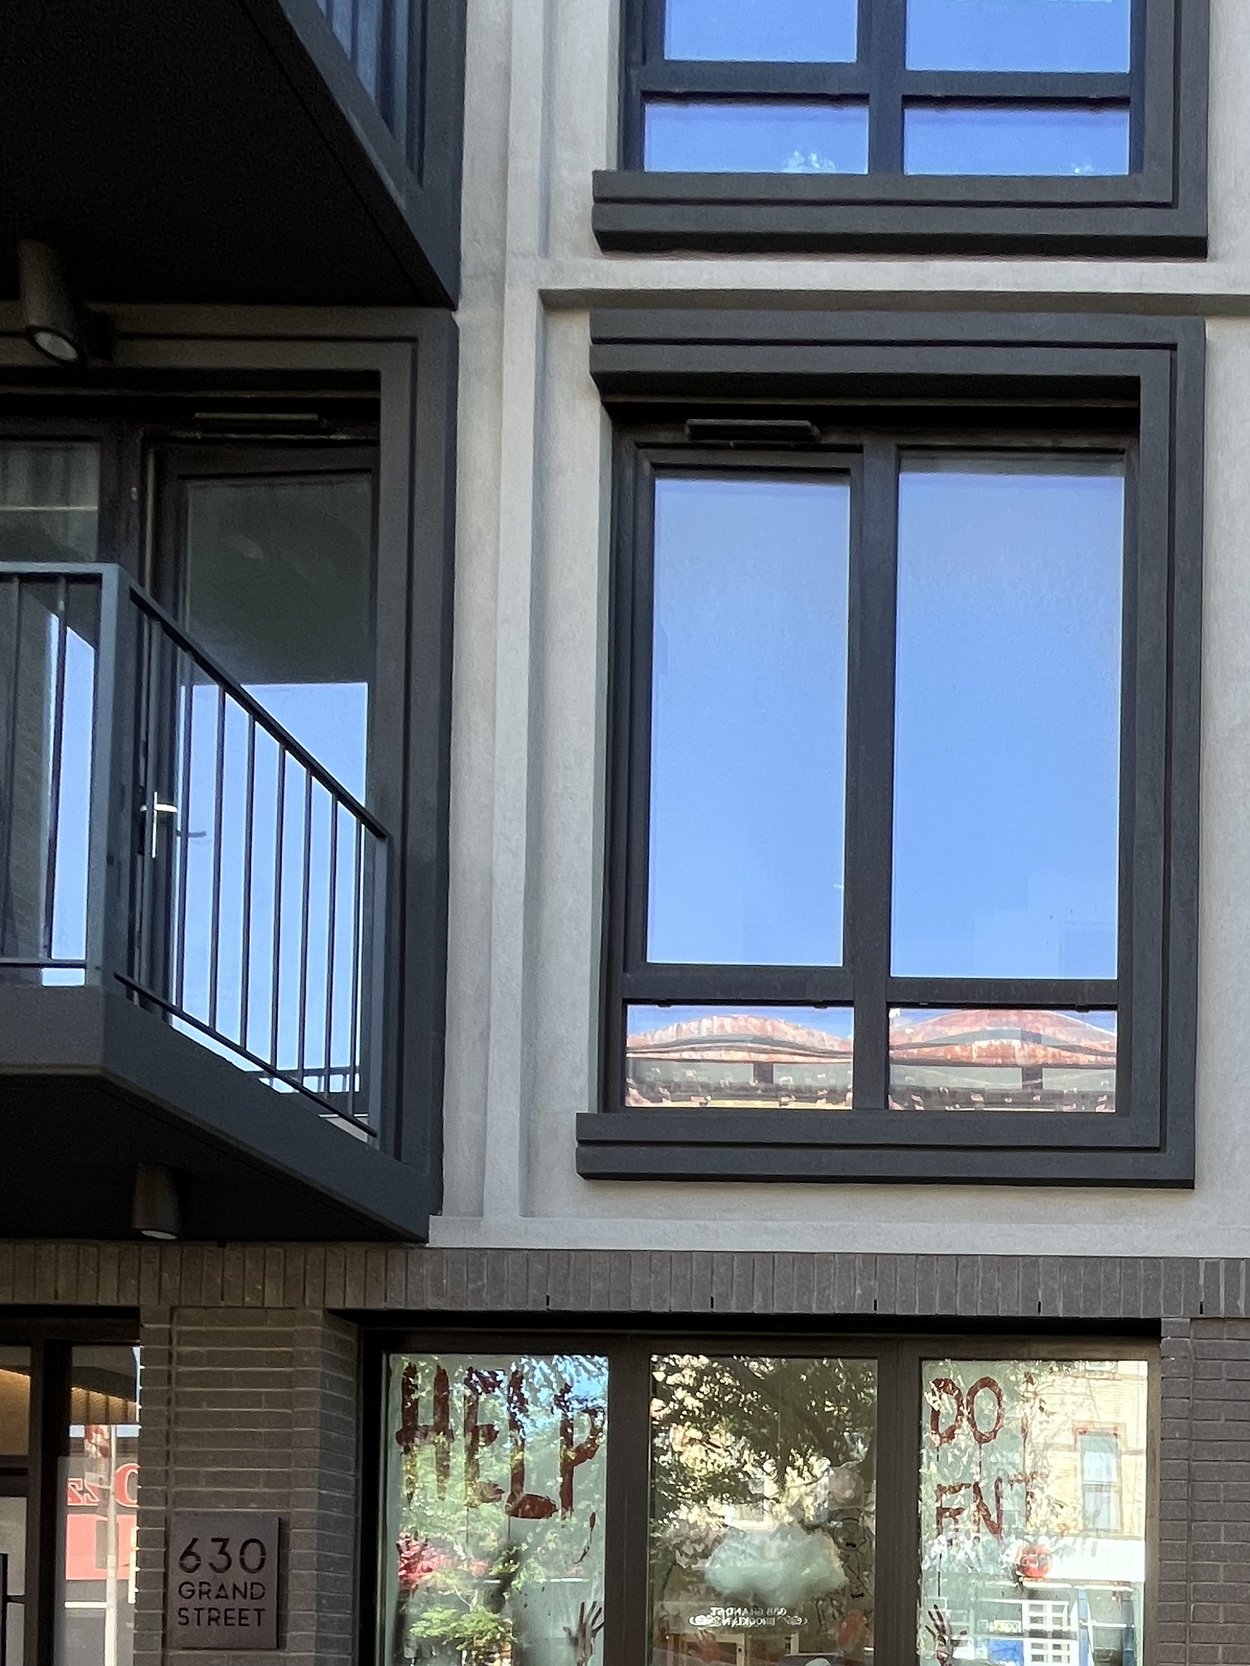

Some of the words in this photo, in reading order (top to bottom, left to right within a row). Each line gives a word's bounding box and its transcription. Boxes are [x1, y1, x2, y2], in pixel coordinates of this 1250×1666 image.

[929, 1376, 1004, 1446] DO
[395, 1363, 606, 1519] HELP
[179, 1538, 266, 1573] 630
[178, 1581, 266, 1600] GRAND
[178, 1607, 266, 1626] STREET
